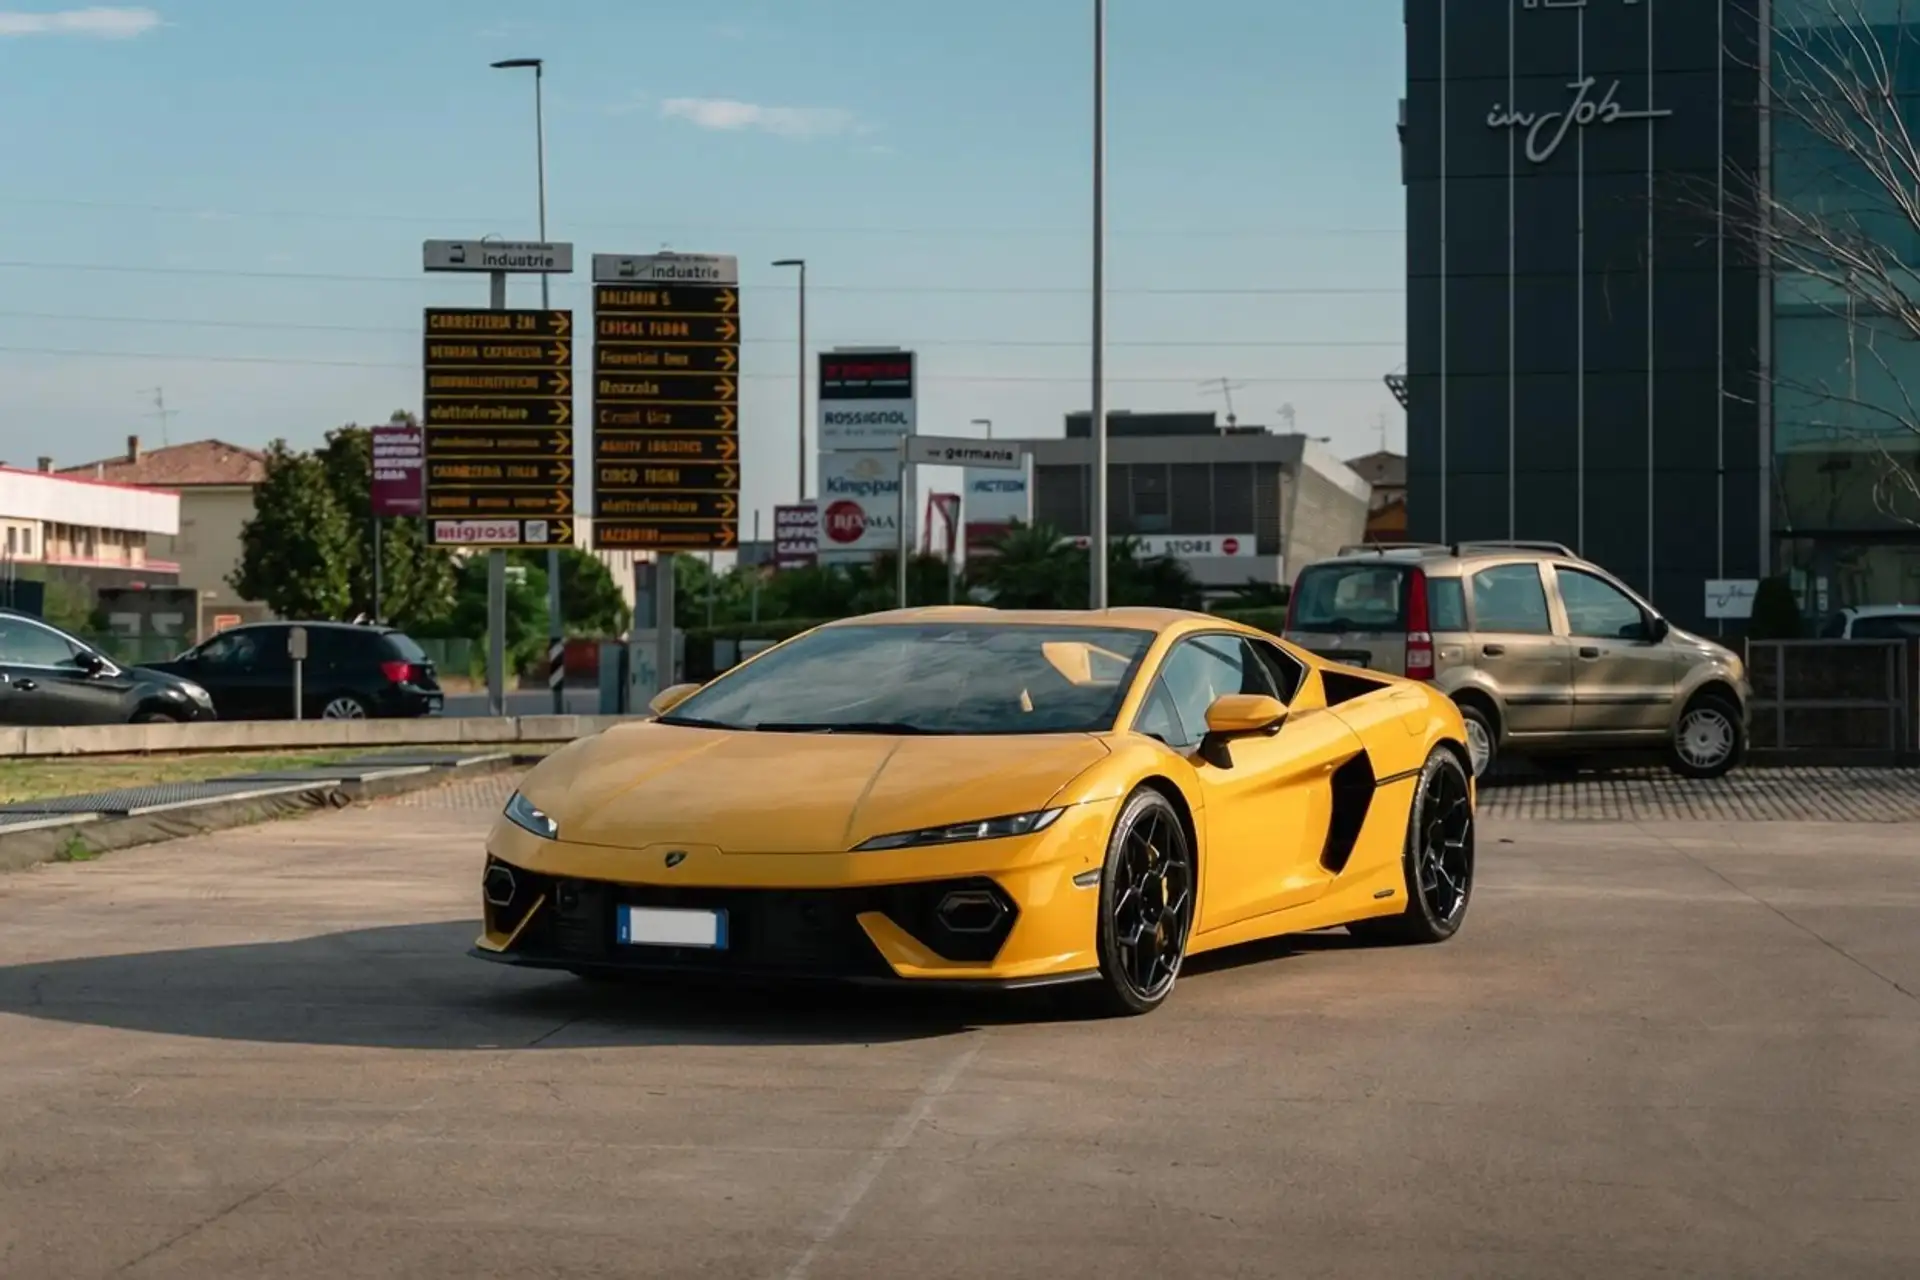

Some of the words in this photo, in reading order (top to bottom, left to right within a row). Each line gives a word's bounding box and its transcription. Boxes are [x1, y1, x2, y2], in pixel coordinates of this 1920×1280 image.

[482, 252, 554, 267] industrie
[652, 264, 720, 279] industrie
[824, 410, 908, 425] ROSSIGNOL
[945, 447, 1014, 462] germania
